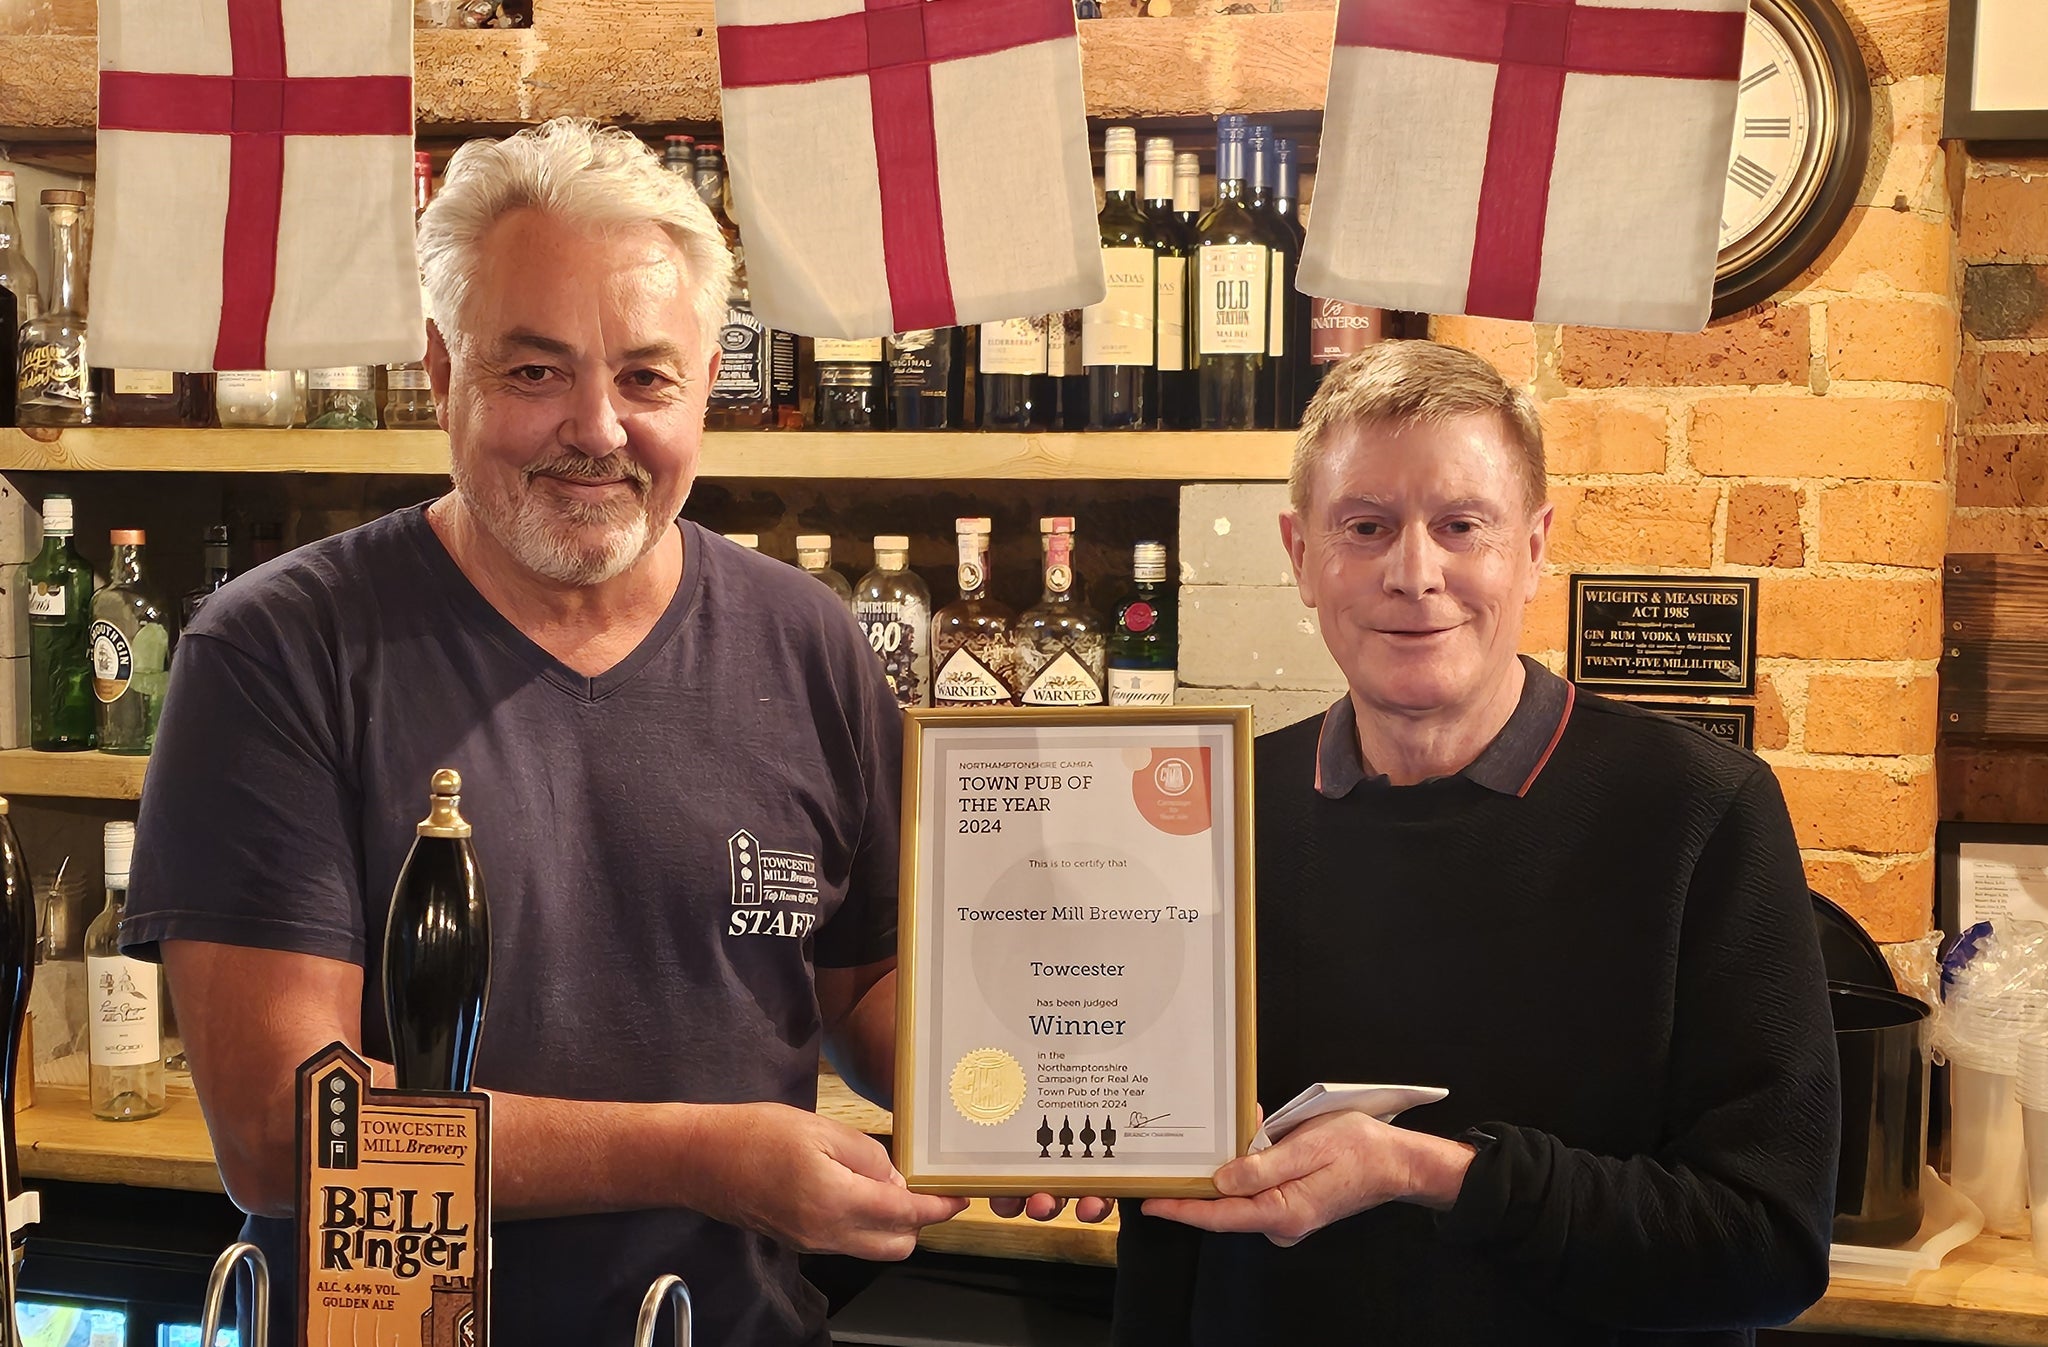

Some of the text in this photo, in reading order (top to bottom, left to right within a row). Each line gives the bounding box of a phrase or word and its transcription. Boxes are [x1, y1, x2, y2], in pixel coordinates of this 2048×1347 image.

[1216, 280, 1249, 310] OLD
[1216, 311, 1249, 325] STATION
[1585, 591, 1738, 605] WEIGHTS & MEASURES
[1632, 607, 1690, 618] ACT 1985
[1584, 630, 1733, 643] GIN RUM VODKA WHISKY
[116, 641, 130, 665] GIN
[1585, 656, 1735, 670] TWENTY-FIVE MILLILITRES
[937, 684, 997, 697] WARNER'S
[1033, 688, 1097, 701] WARNER'S
[1110, 685, 1170, 705] Tanqueray
[959, 761, 1093, 770] NORTHAMPTONSHIRE CAMRA
[959, 775, 1093, 791] TOWN PUB OF
[959, 797, 1051, 812] THE YEAR
[959, 819, 1002, 833] 2024
[1029, 859, 1127, 869] This is to certify that
[763, 869, 789, 881] MILL
[957, 906, 1199, 923] Towcester Mill Brewery Tap
[728, 909, 816, 938] STAFF
[1030, 962, 1125, 977] Towcester
[1036, 999, 1118, 1008] has been judged
[1028, 1015, 1126, 1035] Winner
[1049, 1051, 1066, 1059] the
[1037, 1063, 1128, 1072] Northamptonshire
[1037, 1074, 1149, 1084] Campaign for Real Ale
[1038, 1087, 1145, 1096] Town Pub of the Year
[1037, 1099, 1127, 1109] Competition 2024
[361, 1120, 467, 1138] TOWCESTER
[320, 1185, 469, 1238] BELL
[320, 1219, 468, 1279] Ringer
[344, 1283, 372, 1295] 4.4%
[322, 1296, 395, 1310] GOLDEN ALE
